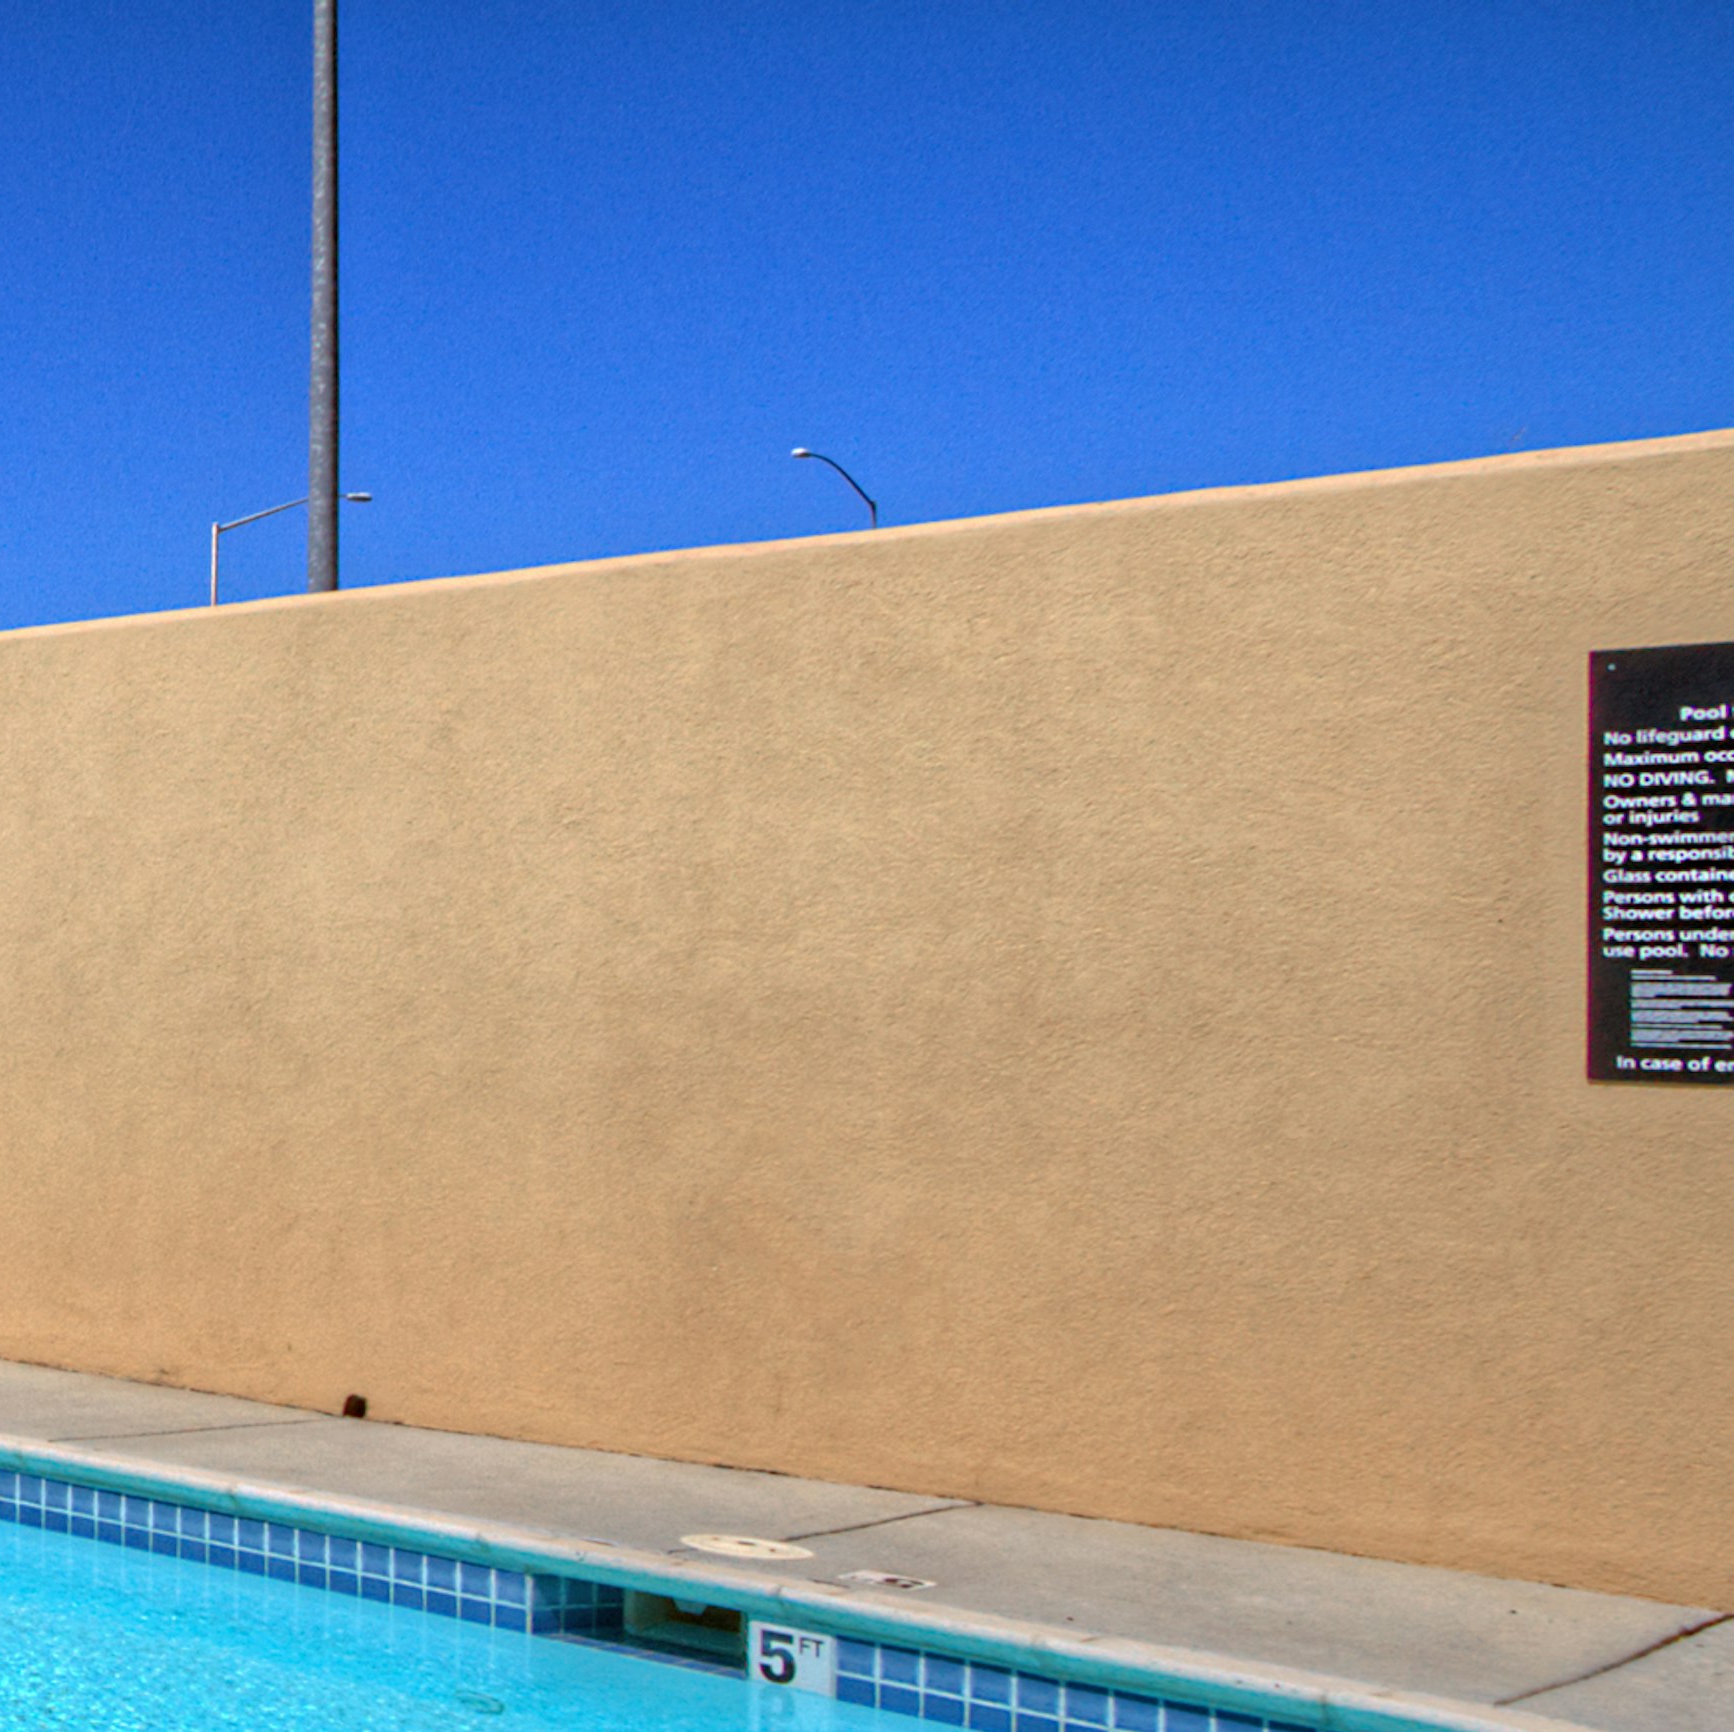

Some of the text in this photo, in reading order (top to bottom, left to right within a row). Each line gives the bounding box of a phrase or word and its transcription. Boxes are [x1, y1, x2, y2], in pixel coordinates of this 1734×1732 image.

[1679, 703, 1727, 721] Pool
[1603, 731, 1633, 746] No
[1636, 725, 1726, 747] lifeguard
[1603, 750, 1700, 767] Maximum
[1603, 772, 1636, 788] NO
[1638, 769, 1716, 787] DIVING.
[1602, 794, 1679, 809] Owners
[1681, 791, 1697, 807] &
[1602, 808, 1700, 828] or injuries
[1602, 847, 1628, 866] by
[1631, 849, 1644, 862] a
[1602, 868, 1652, 884] Glass
[1602, 889, 1676, 905] Persons
[1678, 888, 1725, 904] with
[1602, 905, 1676, 921] Shower
[1602, 926, 1676, 942] Persons
[1602, 942, 1730, 961] use pool. No
[1616, 1055, 1637, 1069] In
[1639, 1057, 1684, 1071] case
[1687, 1056, 1712, 1072] of
[759, 1629, 825, 1685] 5 FT
